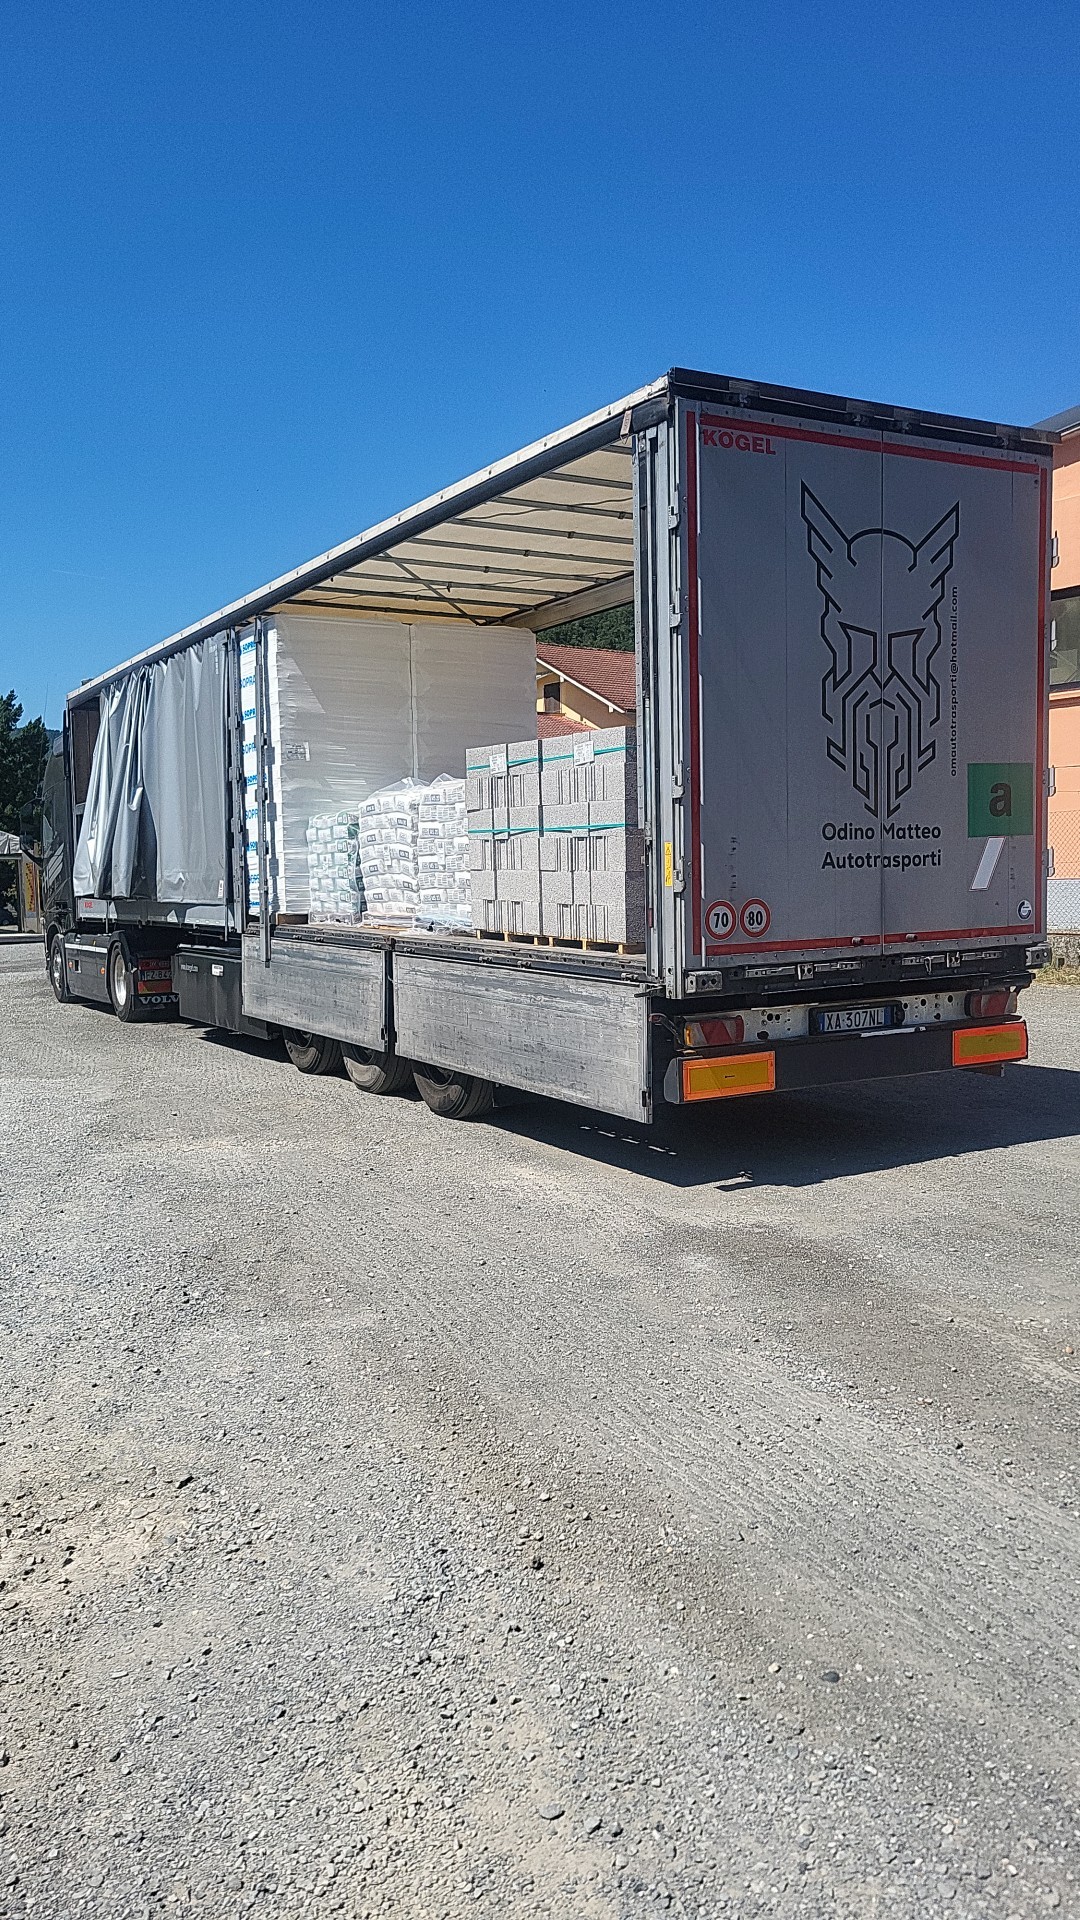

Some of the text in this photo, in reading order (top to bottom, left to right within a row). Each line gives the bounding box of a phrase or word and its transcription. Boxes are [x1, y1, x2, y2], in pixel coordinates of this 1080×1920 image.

[703, 428, 776, 455] KÖGEL
[950, 586, 959, 777] omautotrasporti@hotmail.com
[989, 782, 1012, 817] a
[822, 822, 942, 841] Odino Matteo
[821, 849, 942, 872] Autotrasporti
[713, 912, 729, 928] 70
[747, 910, 764, 927] 80
[139, 995, 180, 1005] VOLV
